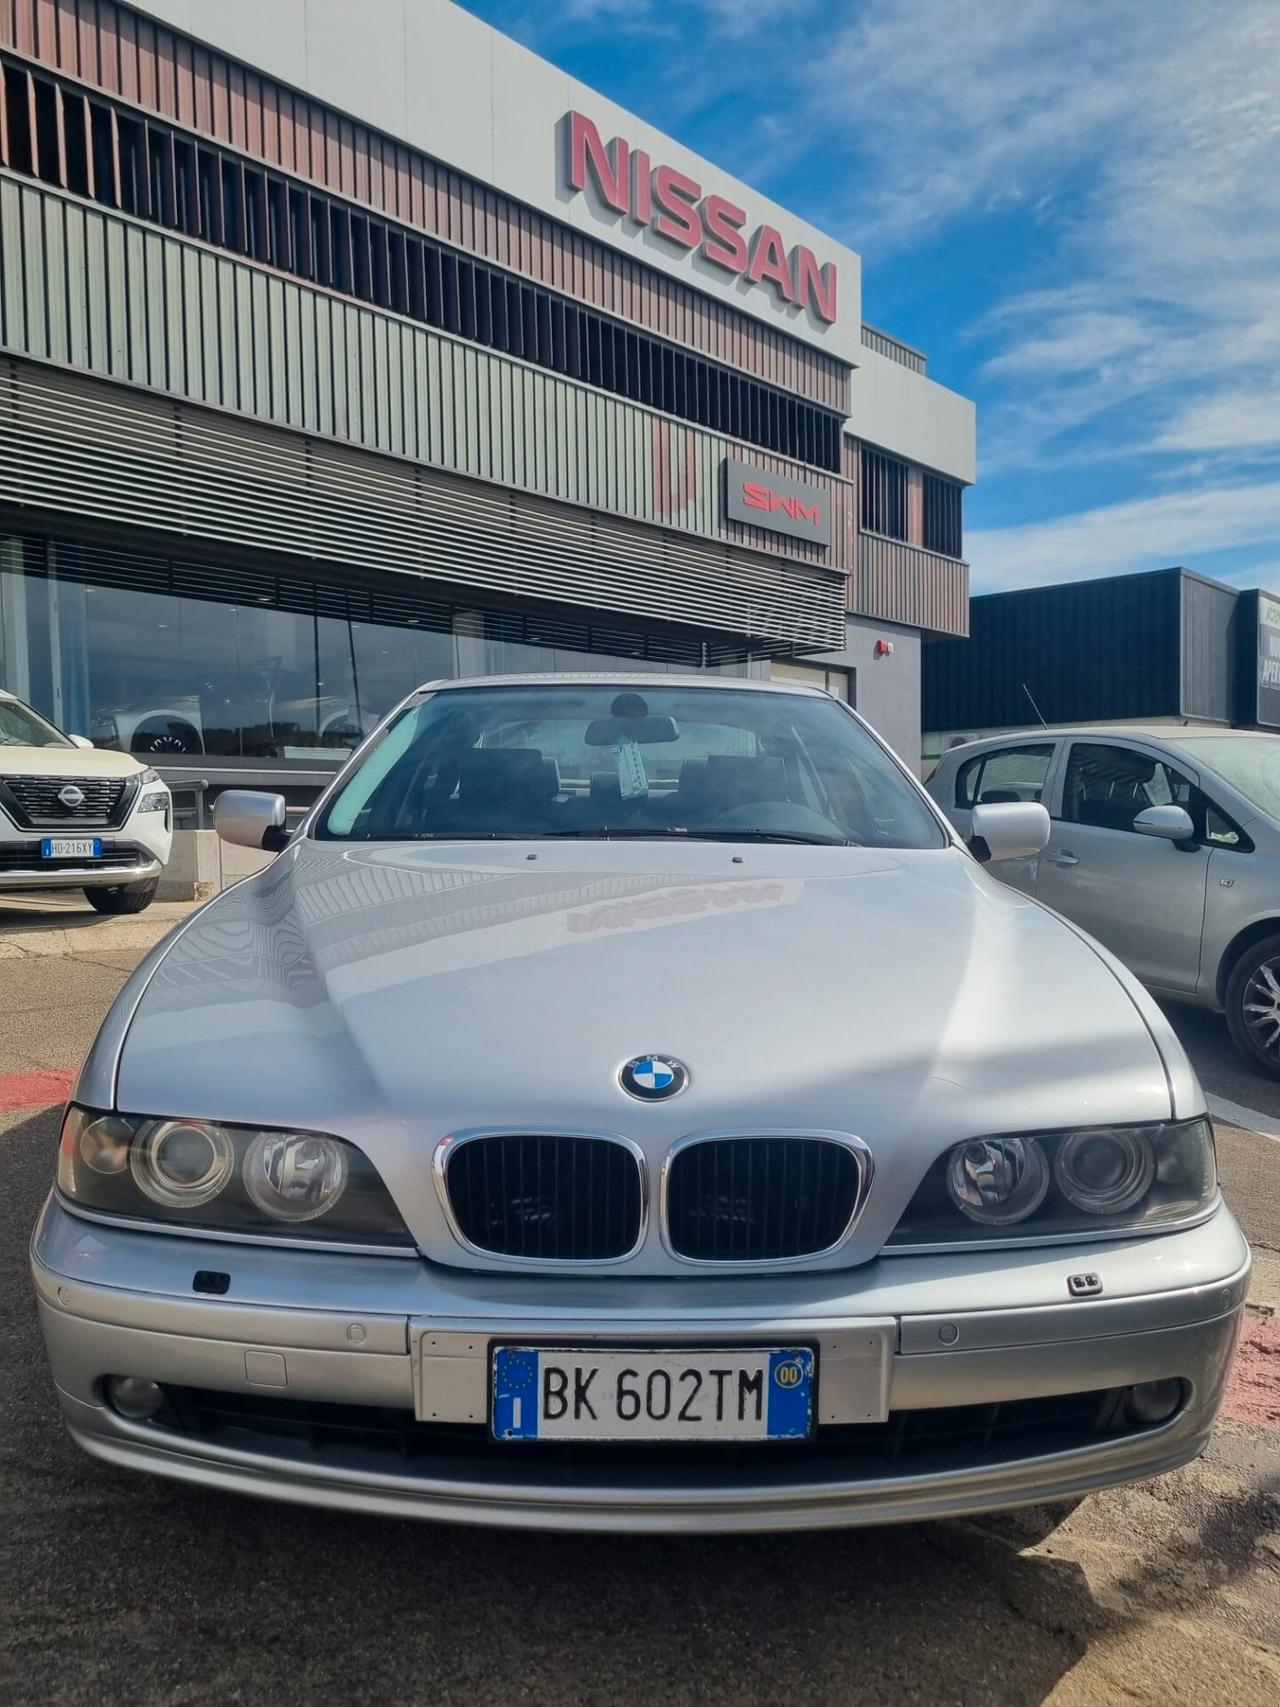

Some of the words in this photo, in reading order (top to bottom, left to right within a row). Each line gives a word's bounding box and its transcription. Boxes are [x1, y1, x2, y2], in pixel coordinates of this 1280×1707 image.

[563, 110, 837, 324] NISSAN
[742, 480, 820, 527] SWM
[543, 1367, 599, 1420] BK
[616, 1368, 763, 1421] 602TM
